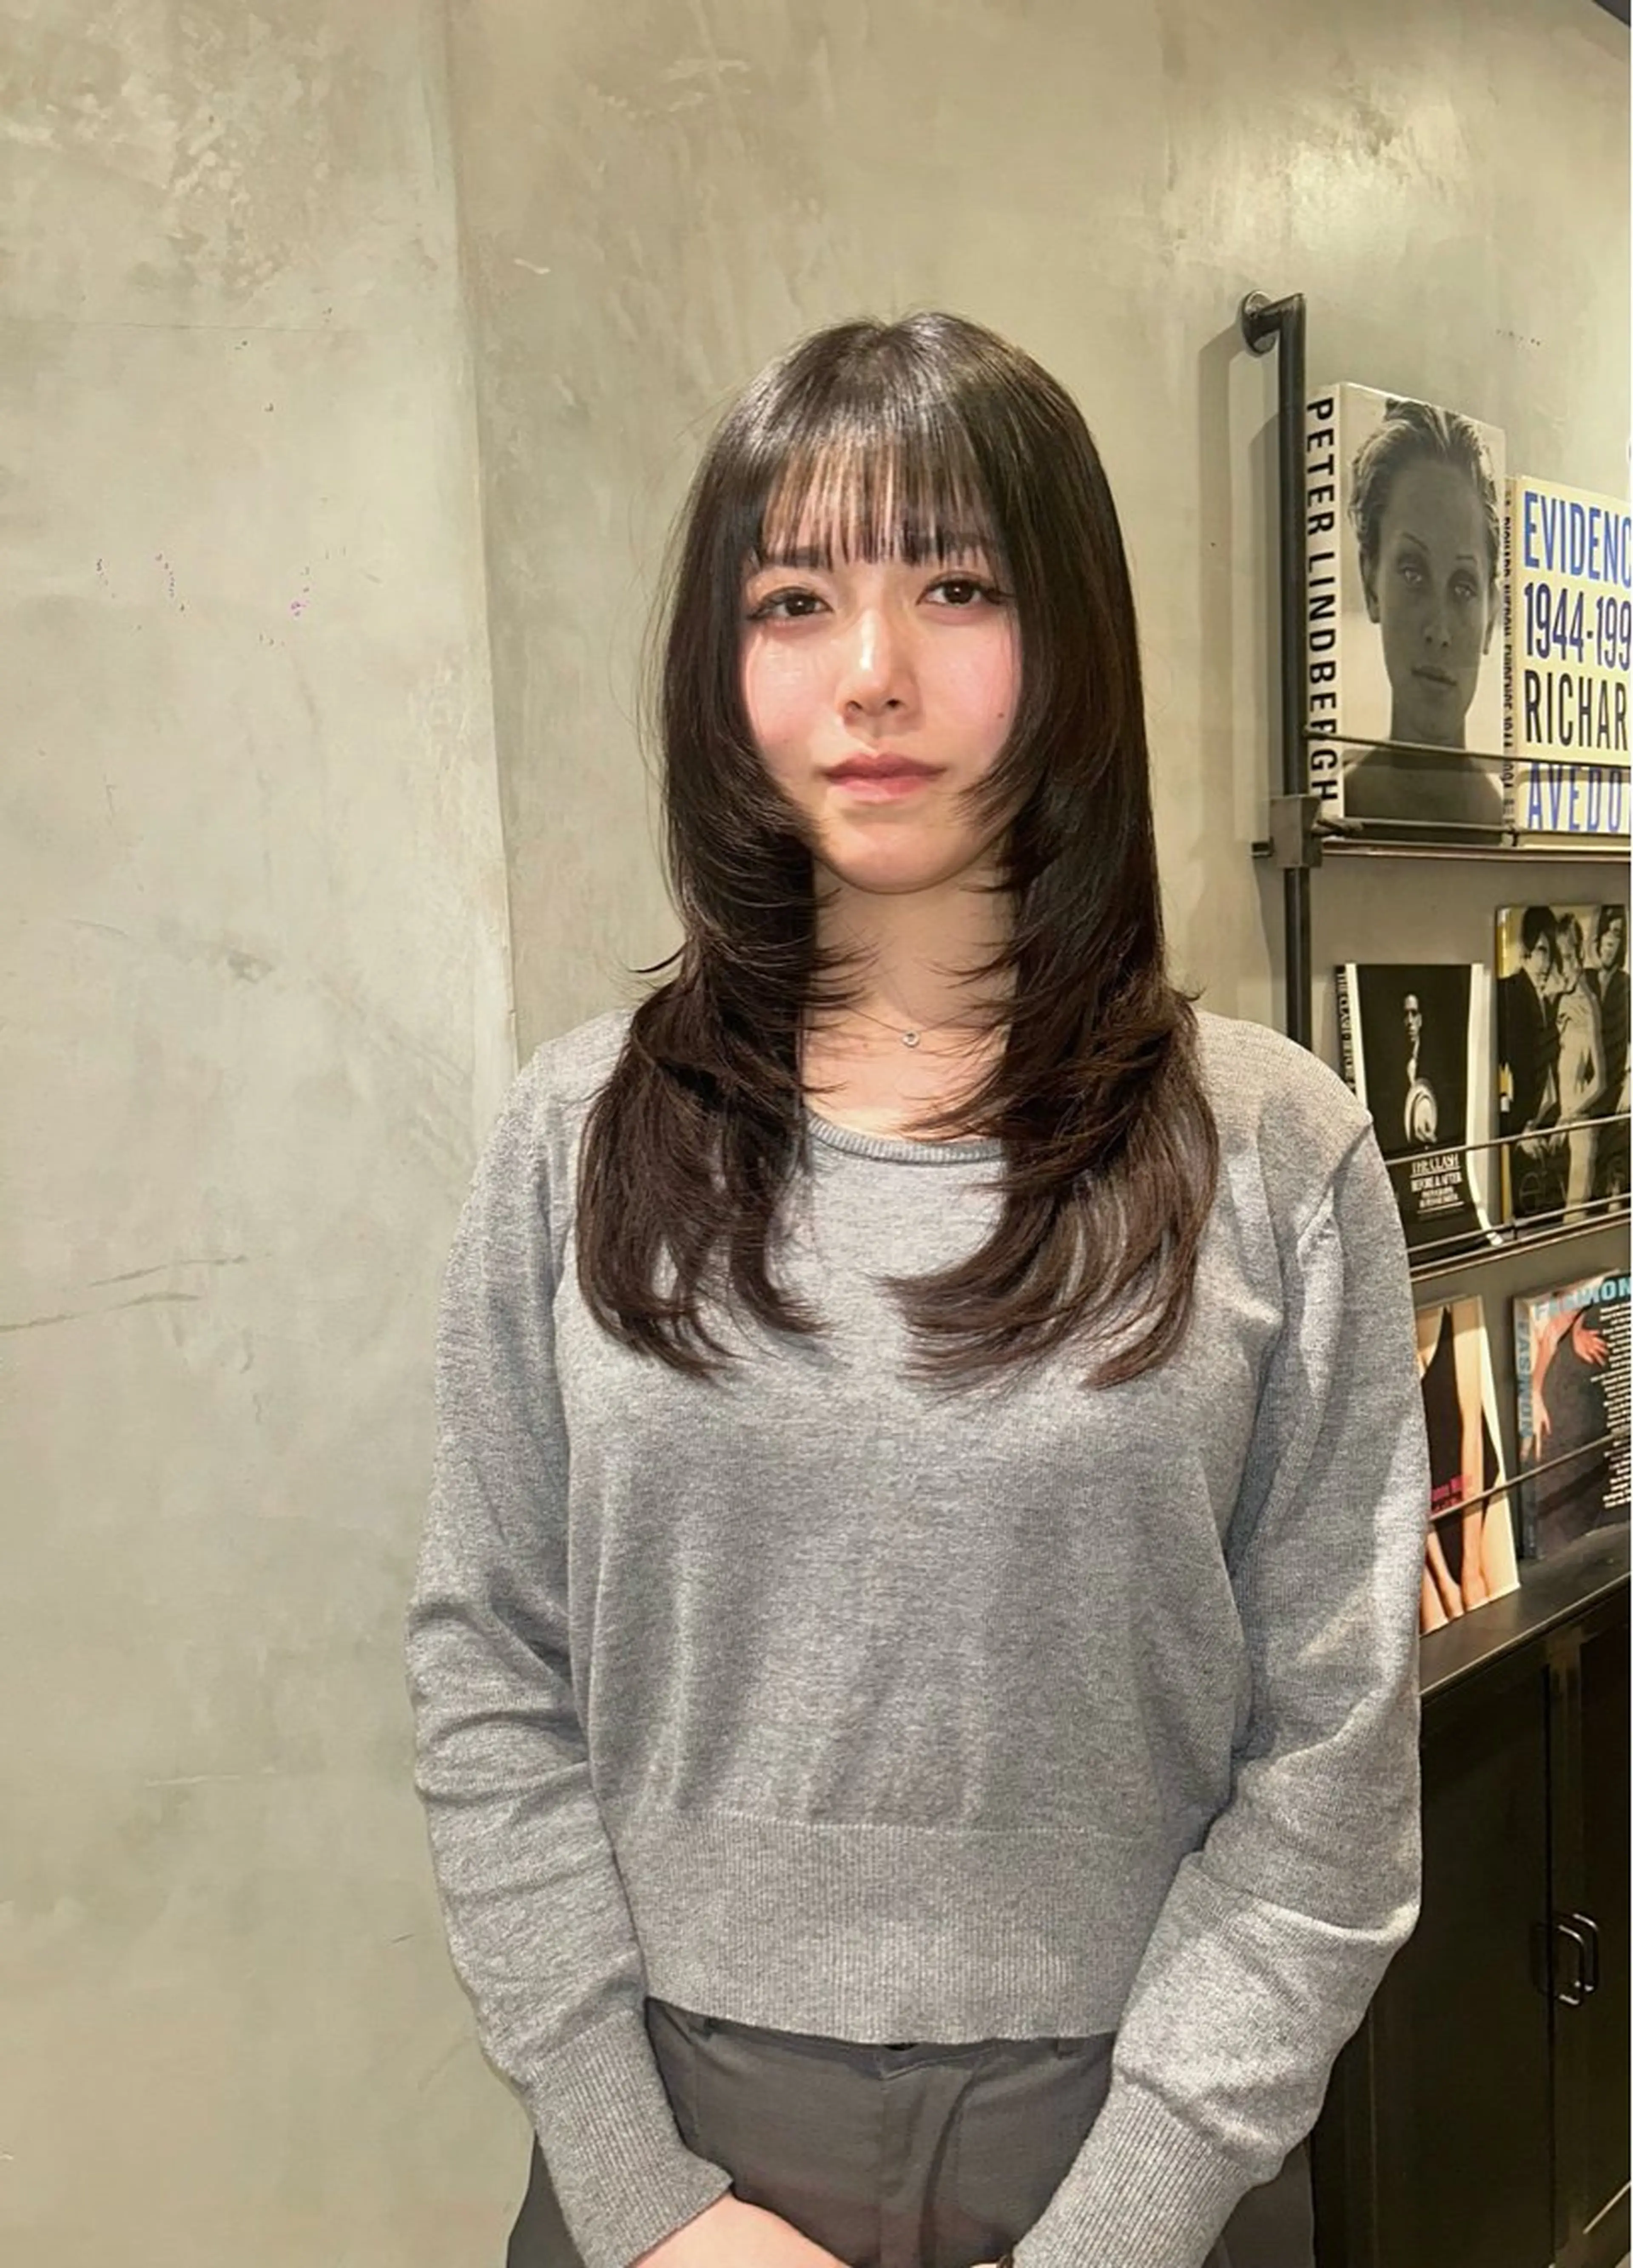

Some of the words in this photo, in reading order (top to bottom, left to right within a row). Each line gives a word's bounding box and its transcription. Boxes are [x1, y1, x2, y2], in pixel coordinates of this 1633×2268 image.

[1306, 397, 1334, 536] PETER
[1524, 490, 1631, 589] EVIDENC
[1524, 582, 1631, 671] 1944-199
[1525, 669, 1628, 751] RICHAR
[1528, 762, 1631, 833] AVEDO
